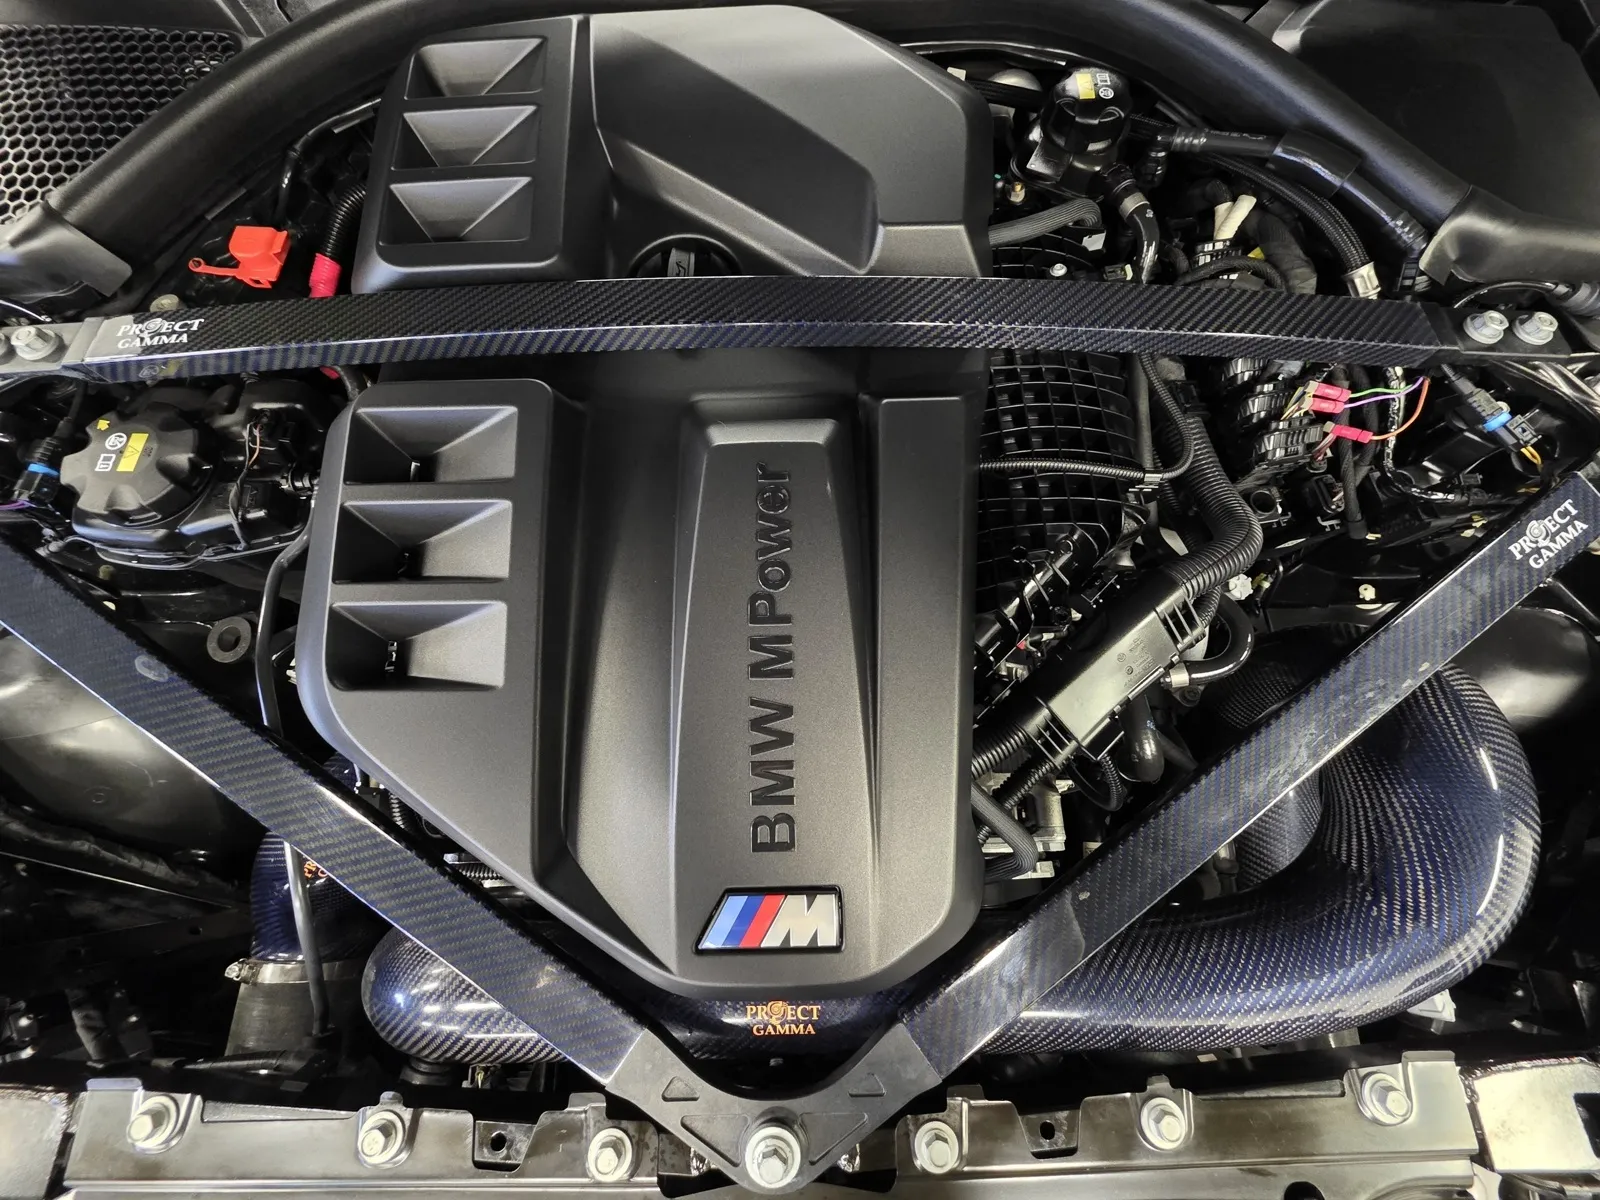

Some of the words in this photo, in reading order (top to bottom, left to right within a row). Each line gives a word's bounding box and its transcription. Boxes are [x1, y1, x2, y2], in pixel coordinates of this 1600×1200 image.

[117, 333, 188, 348] GAMMA
[1529, 520, 1588, 569] GAMMA
[748, 696, 796, 853] BMW
[752, 1024, 816, 1036] GAMMA
